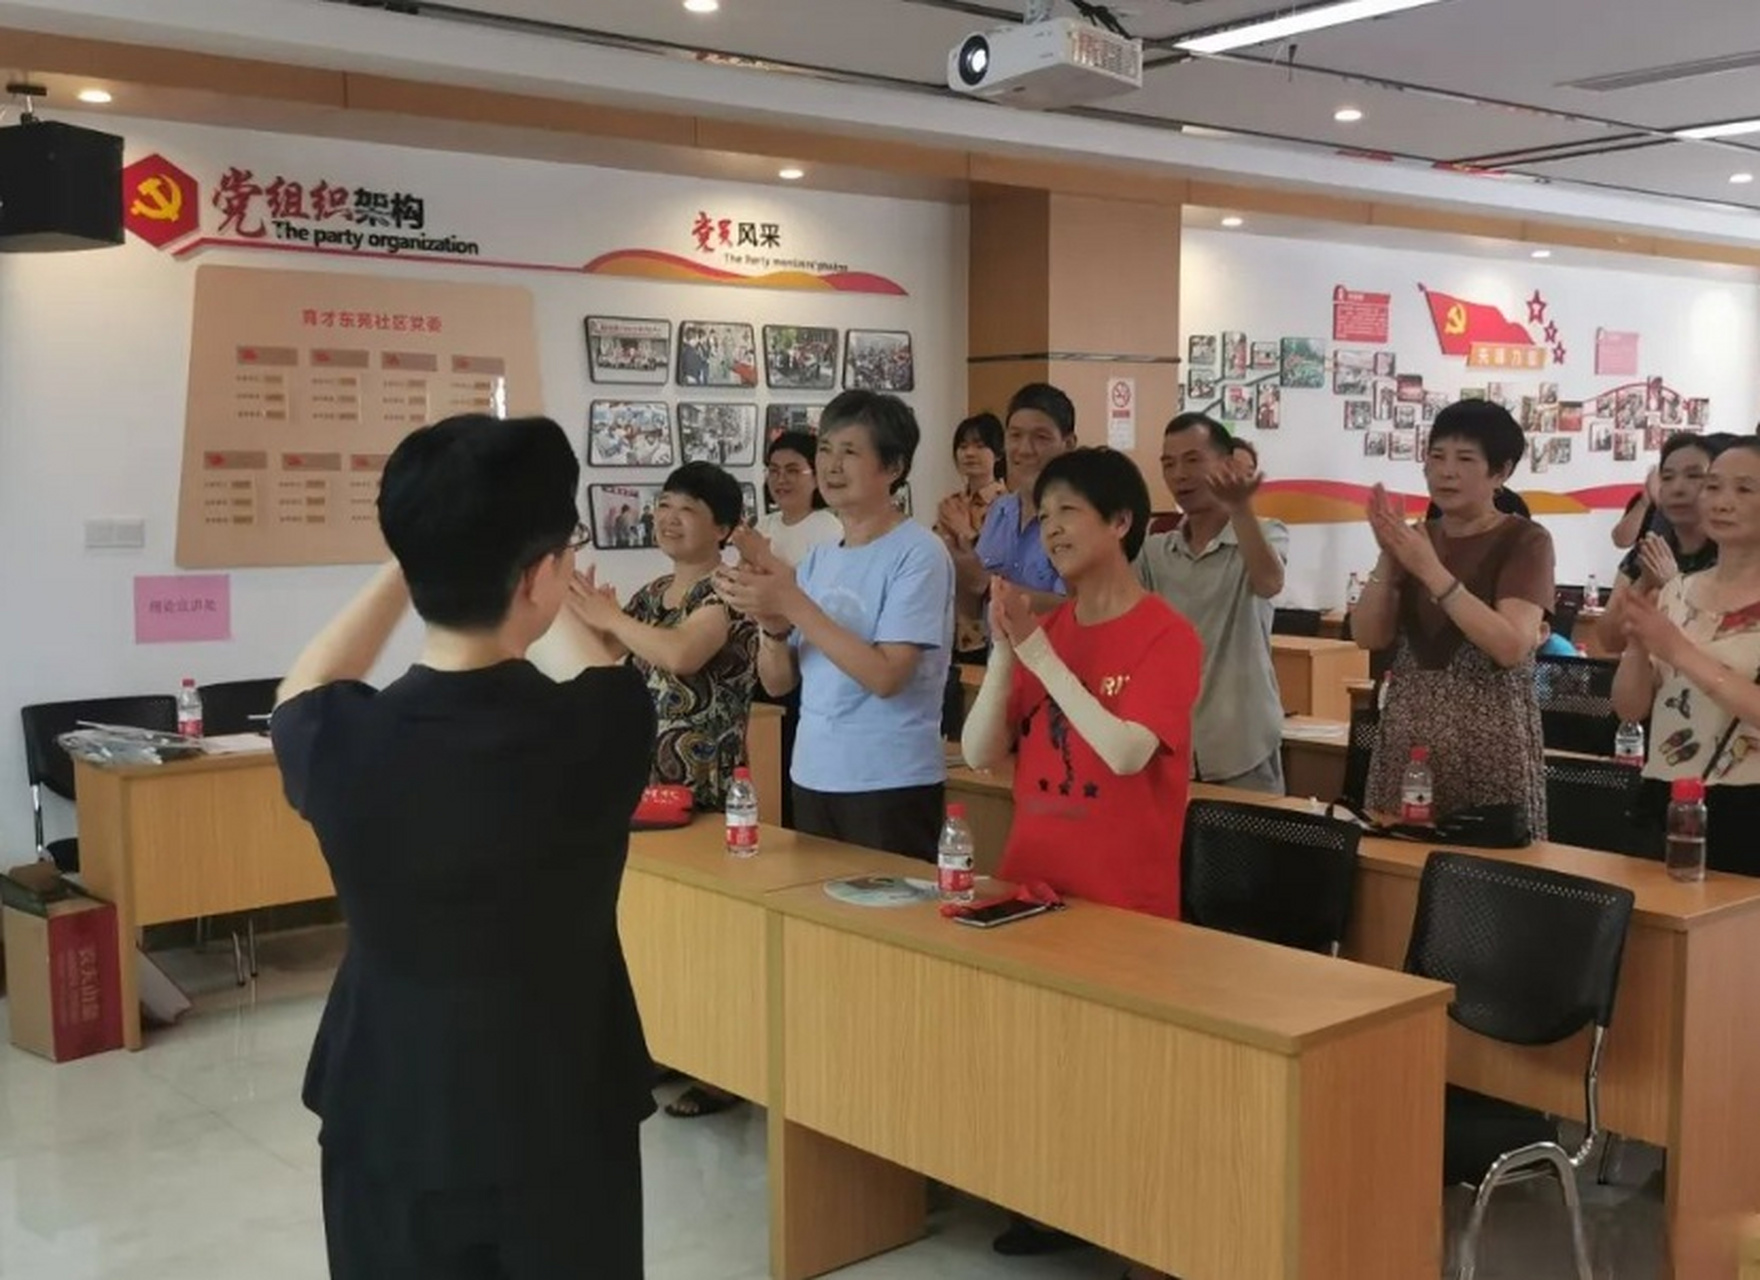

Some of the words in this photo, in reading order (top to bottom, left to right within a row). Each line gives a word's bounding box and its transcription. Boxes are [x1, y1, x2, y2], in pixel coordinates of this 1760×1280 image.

[212, 166, 424, 238] 党组织架构
[273, 220, 308, 241] The
[314, 228, 361, 248] party
[368, 233, 480, 256] organization
[691, 211, 781, 252] 党员风采
